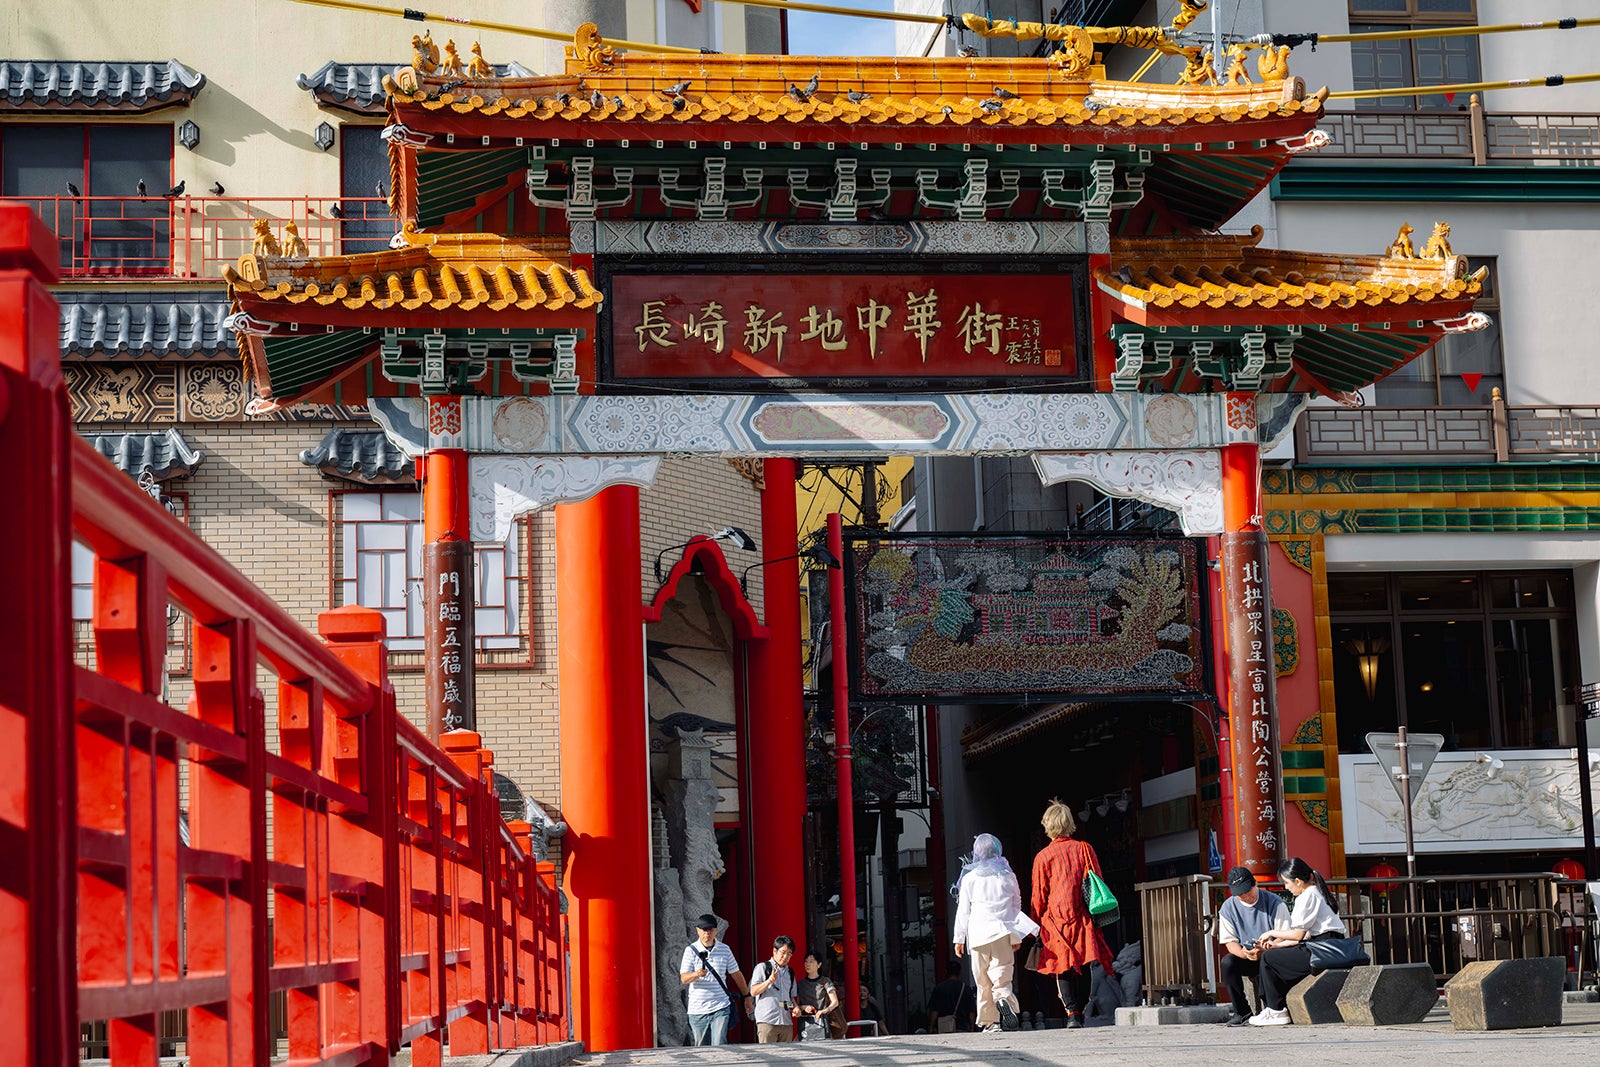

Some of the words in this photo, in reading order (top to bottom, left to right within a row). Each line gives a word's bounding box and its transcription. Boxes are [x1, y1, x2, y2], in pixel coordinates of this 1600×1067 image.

[634, 288, 1004, 364] 長崎新地中華街
[1005, 316, 1023, 365] 王震
